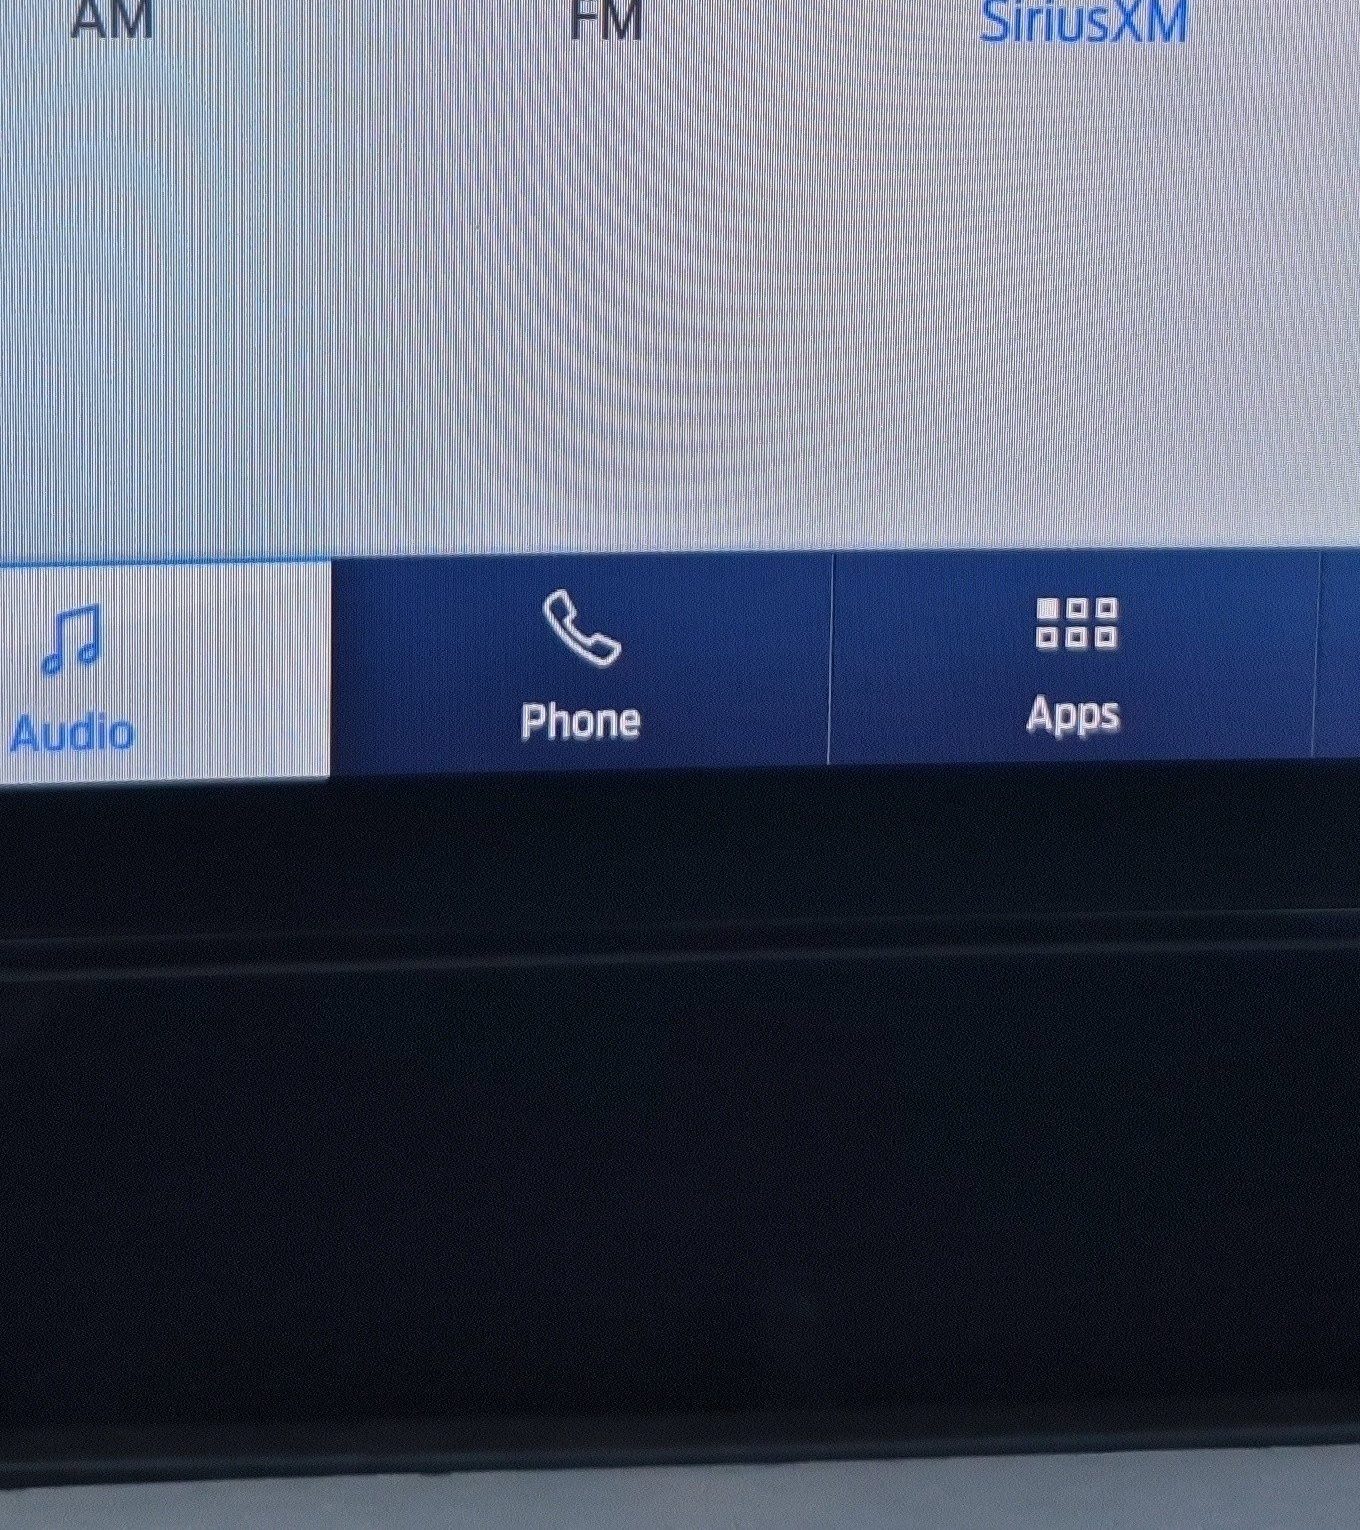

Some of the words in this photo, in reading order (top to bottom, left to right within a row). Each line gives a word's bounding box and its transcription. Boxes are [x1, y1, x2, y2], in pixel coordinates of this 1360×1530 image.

[8, 712, 136, 754] Audio
[520, 700, 641, 741] Phone
[1026, 694, 1122, 738] Apps
